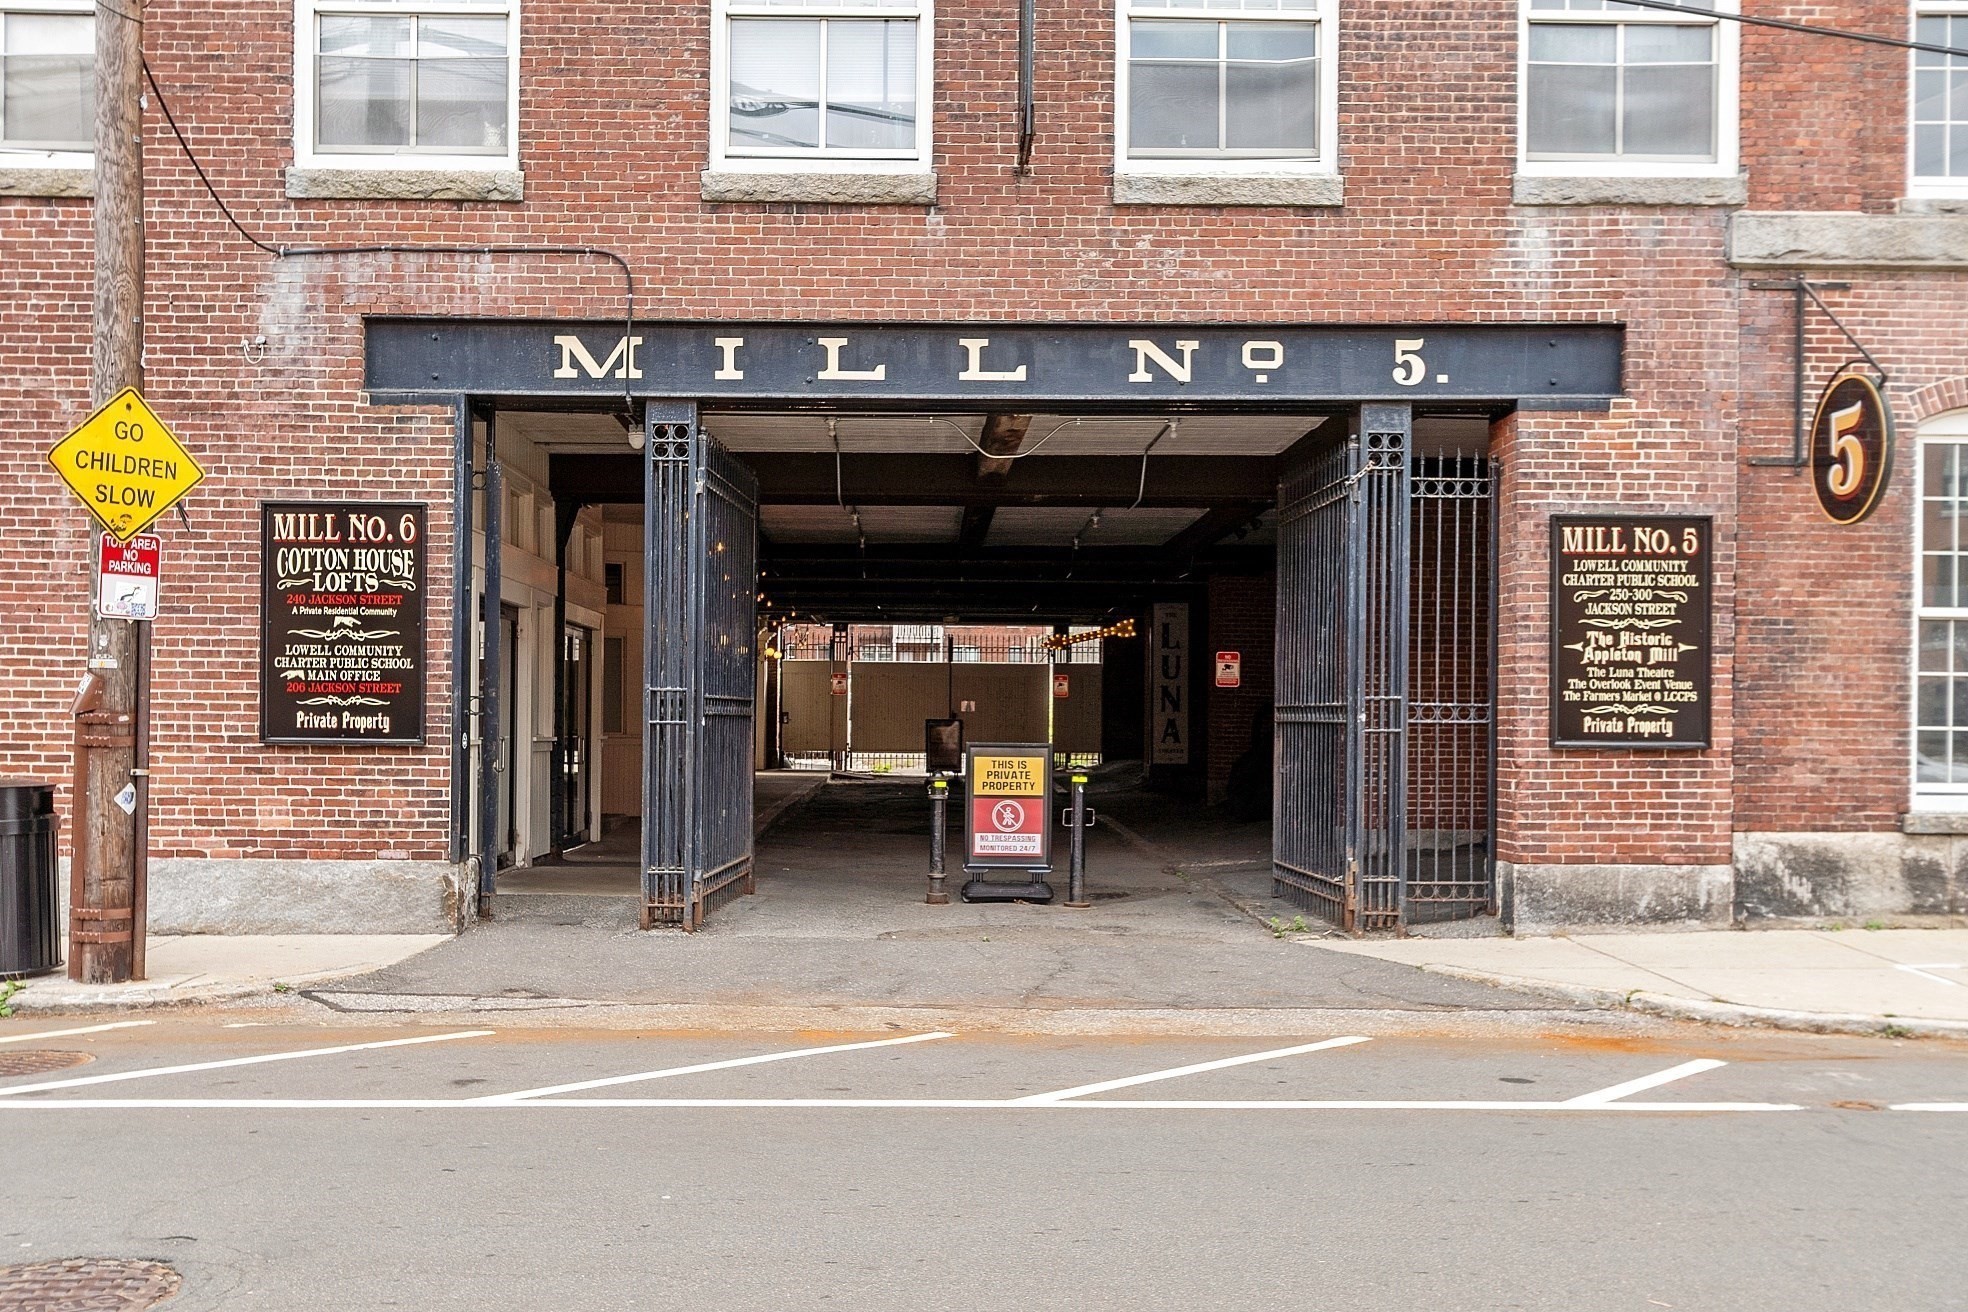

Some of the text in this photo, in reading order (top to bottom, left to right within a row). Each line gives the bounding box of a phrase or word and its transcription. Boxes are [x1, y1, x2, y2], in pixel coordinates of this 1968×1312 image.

[553, 335, 1027, 381] MILL
[114, 420, 144, 442] GO
[1827, 400, 1867, 500] 5
[75, 450, 177, 480] CHILDREN
[95, 484, 155, 508] SLOW
[273, 513, 417, 543] MILL NO. 6
[131, 538, 158, 551] AREA
[1562, 527, 1698, 556] MILL NO. 5
[123, 549, 138, 561] NO
[108, 560, 152, 574] PARKING
[277, 548, 415, 580] COTTON HOUSE
[1573, 560, 1688, 572] LOWELL COMMUNITY
[313, 572, 379, 593] LOFTS
[1562, 574, 1699, 586] CHARTER PUBLIC SCHOOL
[286, 594, 403, 605] 240 JACKSON STREET
[1609, 588, 1652, 600] 250-300
[292, 606, 397, 617] A Private Residential Community
[1585, 603, 1677, 615] JACKSON STREET
[1586, 631, 1673, 649] The Historic
[285, 644, 403, 656] LOWELL COMMUNITY
[1580, 647, 1677, 665] Appleton Mill
[274, 657, 414, 669] CHARTER PUBLIC SCHOOL
[307, 670, 381, 681] MAIN OFFICE
[1586, 667, 1674, 678] The Luna Theatre
[286, 682, 402, 693] 206 JACKSON STREET
[1160, 622, 1181, 744] LUNA
[1568, 679, 1693, 690] The Overlook Event Venue
[1563, 690, 1580, 701] The
[1583, 691, 1620, 701] Farmers
[1622, 691, 1652, 702] Market
[1663, 691, 1697, 702] LCCPS
[296, 710, 390, 733] Private Property
[1583, 716, 1673, 737] Private Property
[992, 760, 1027, 769] THIS IS
[986, 771, 1031, 779] PRIVATE
[982, 782, 1035, 790] PROPERTY
